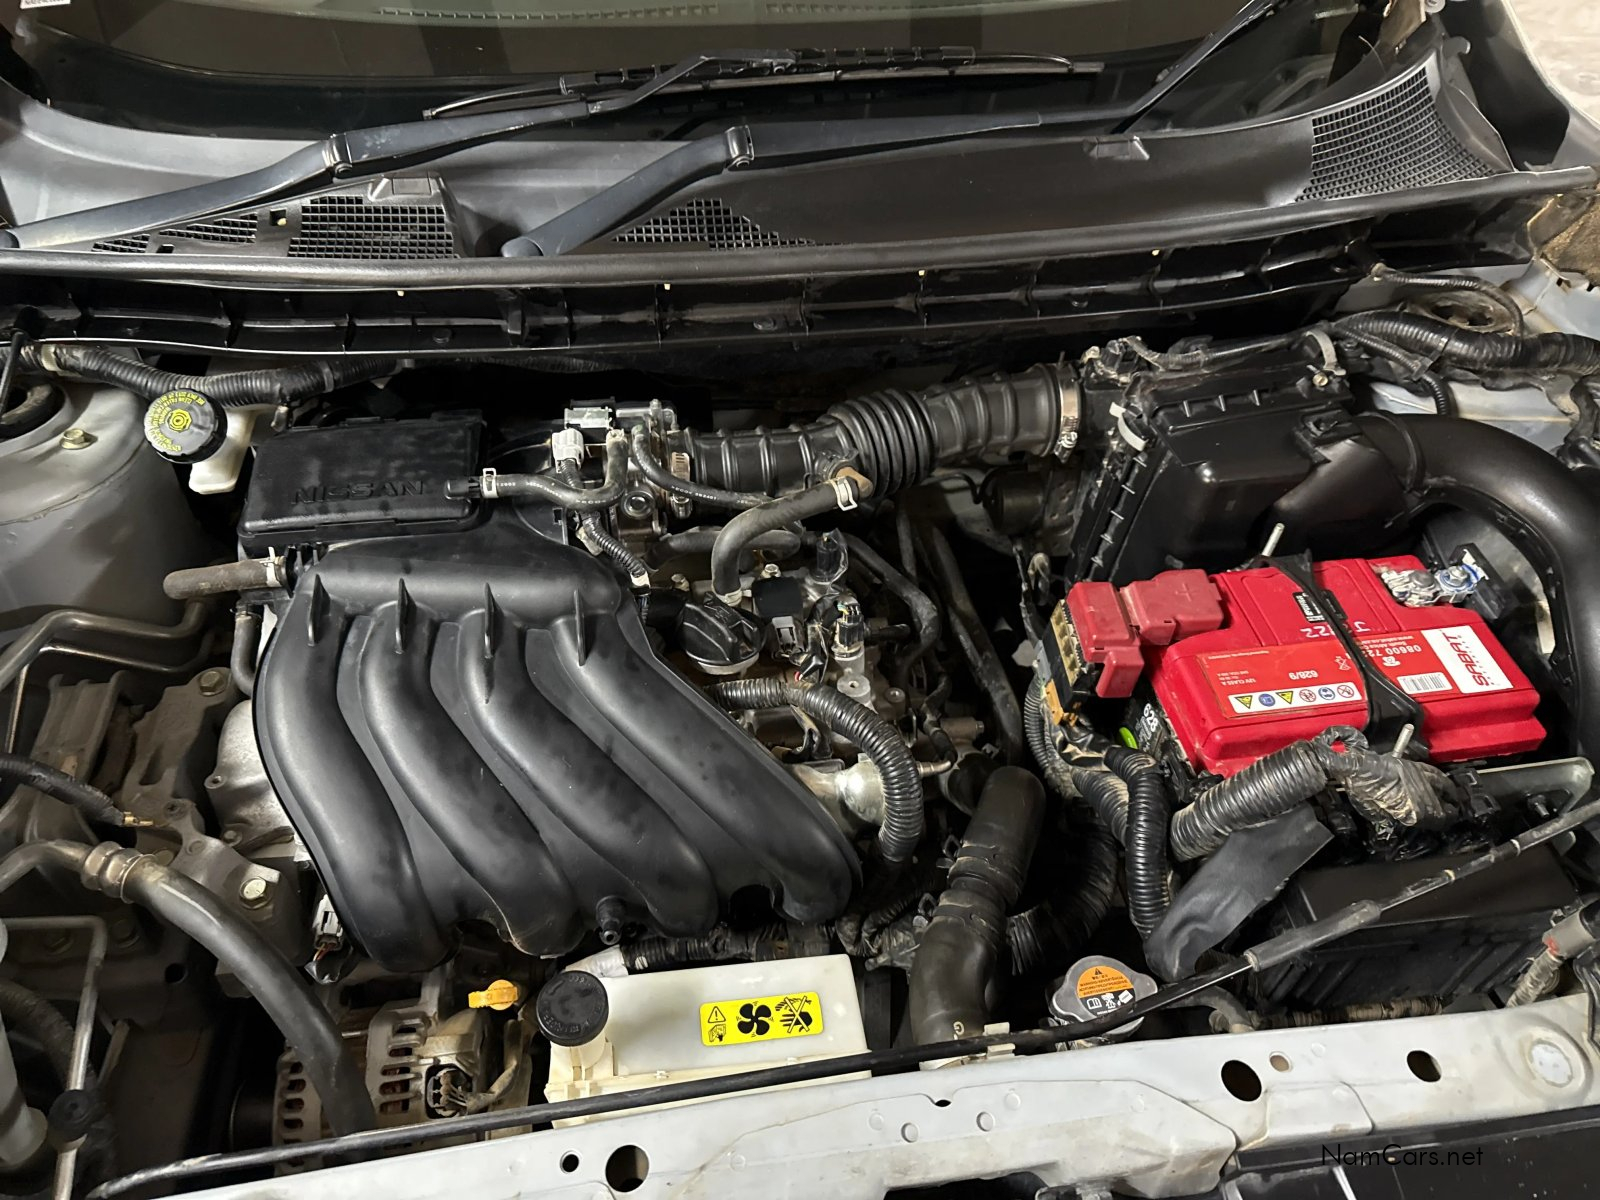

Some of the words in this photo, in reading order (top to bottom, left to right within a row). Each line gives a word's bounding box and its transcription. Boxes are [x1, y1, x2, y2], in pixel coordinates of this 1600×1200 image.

[291, 481, 424, 505] NISSAN
[1385, 645, 1422, 656] 08600
[1442, 632, 1490, 687] SABAT
[1288, 669, 1319, 680] 628/9
[1143, 703, 1159, 733] 628
